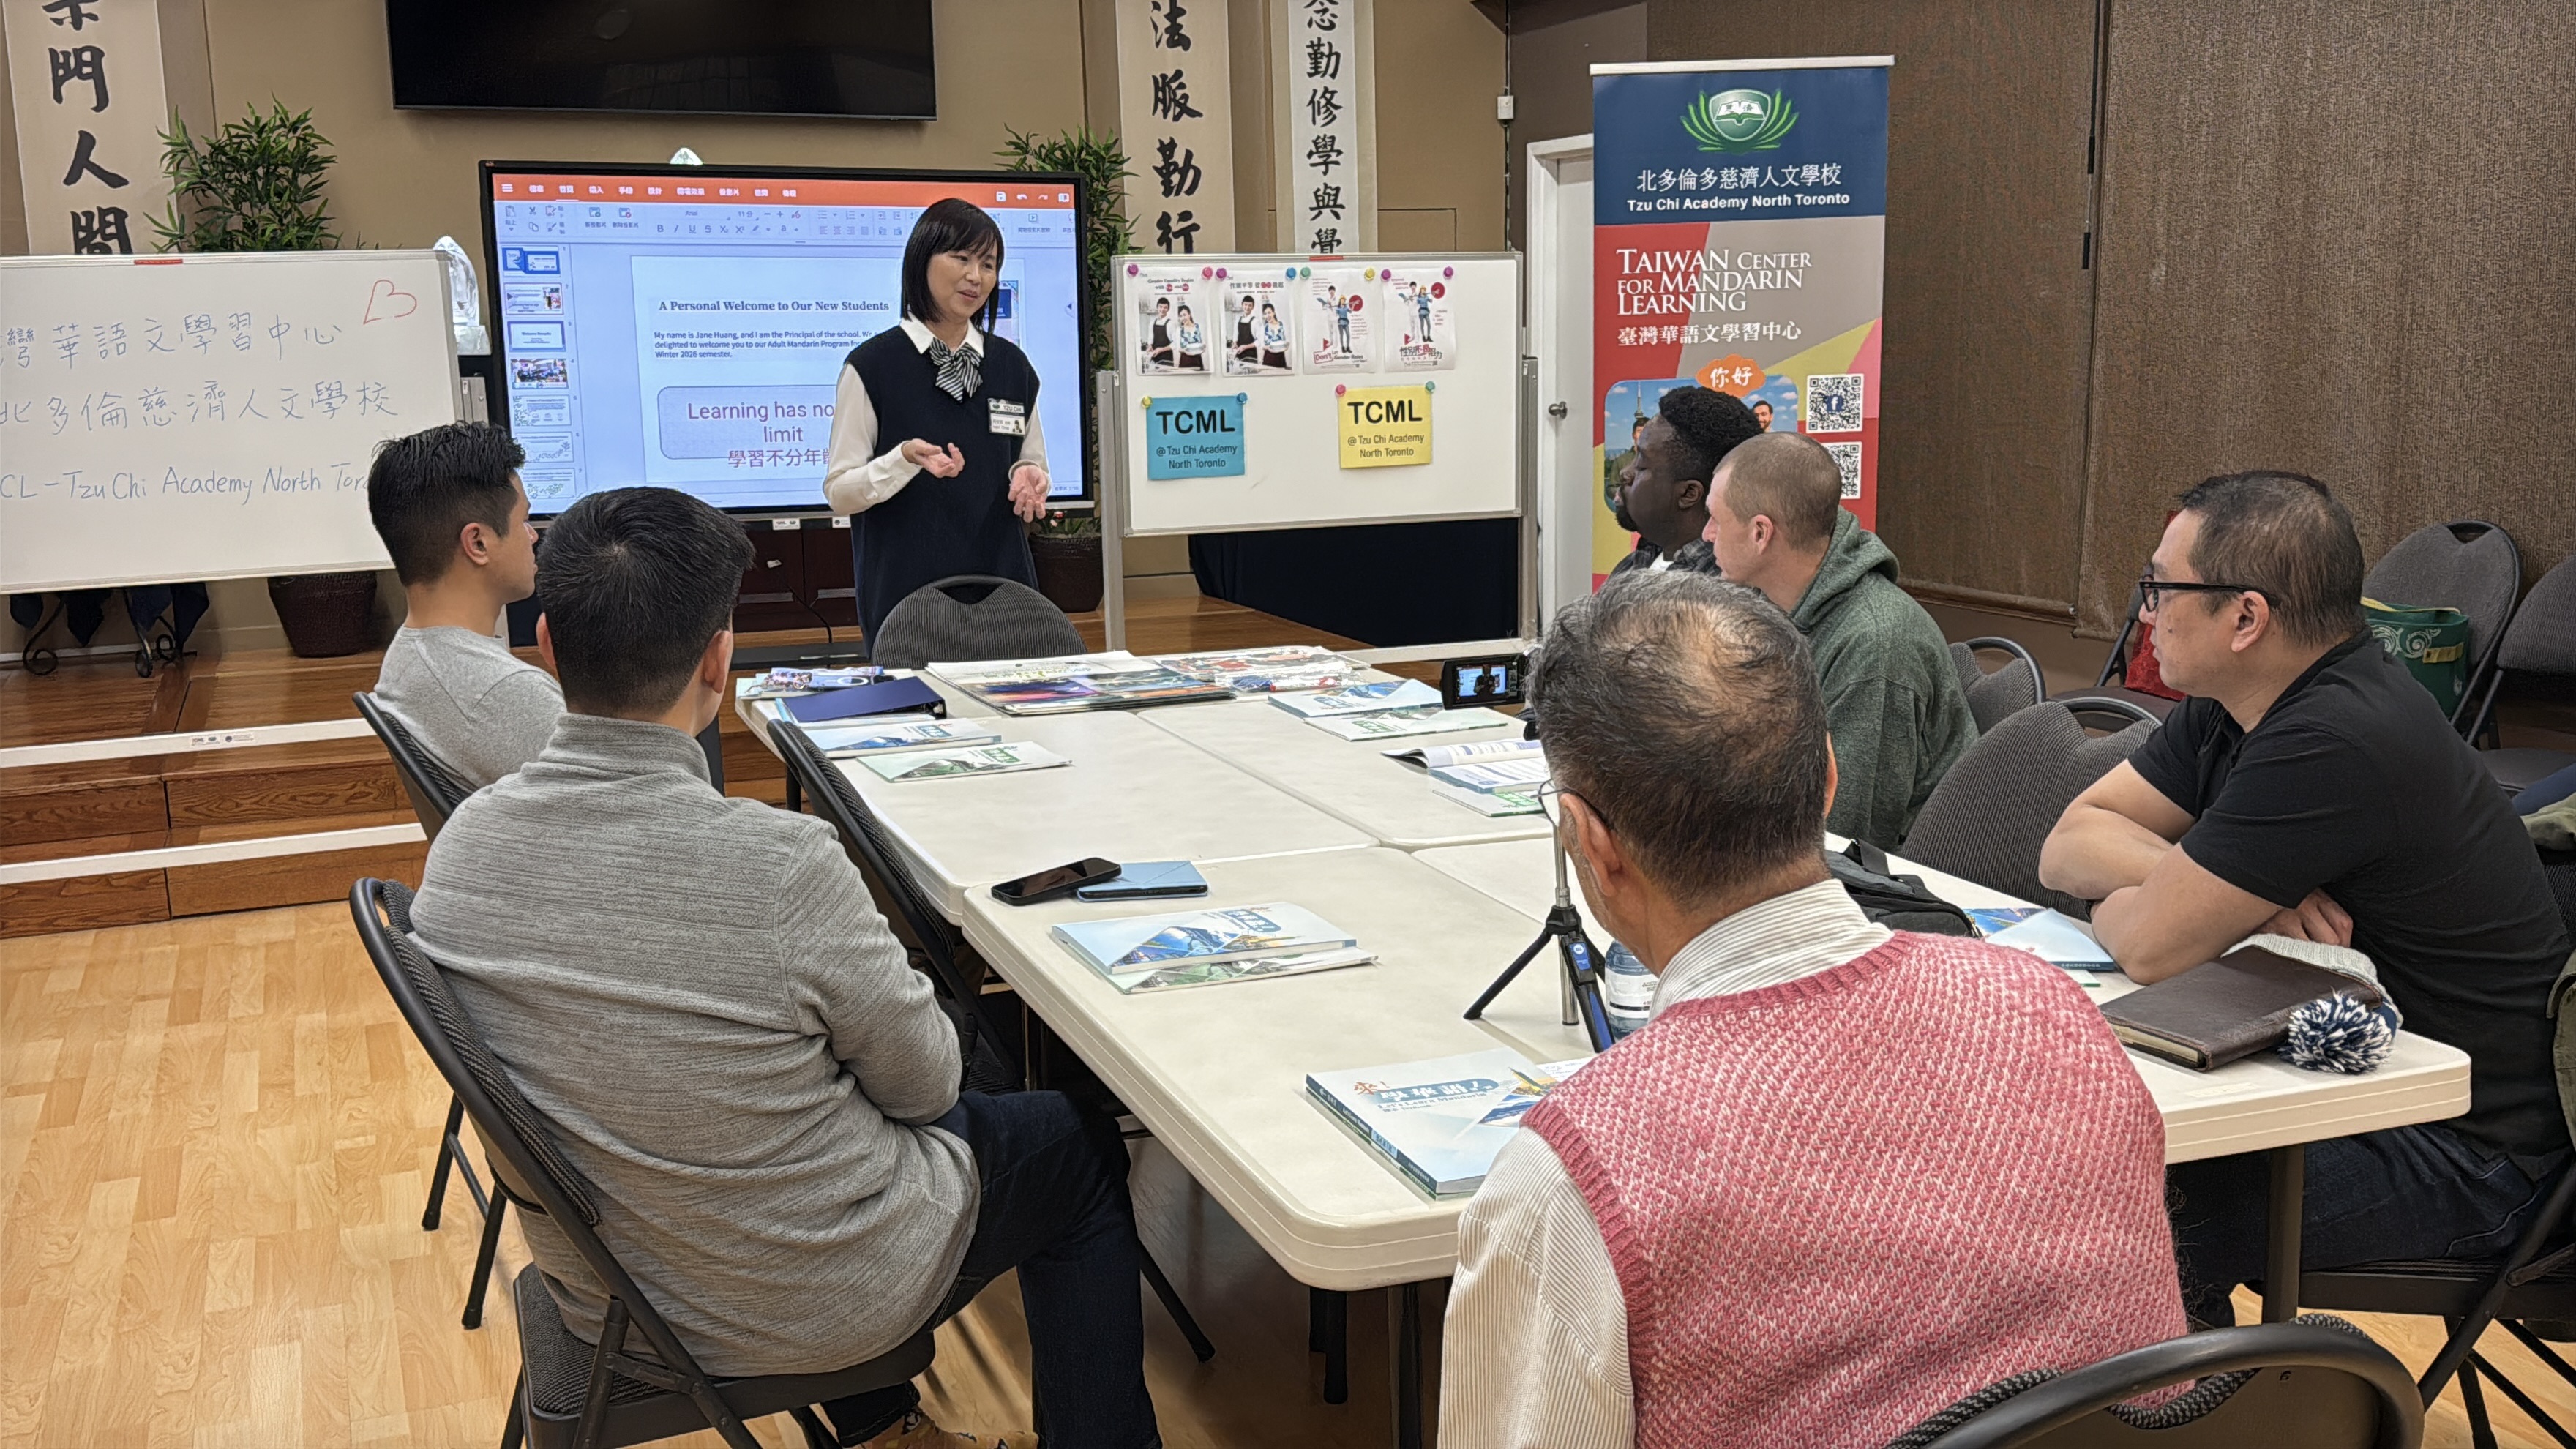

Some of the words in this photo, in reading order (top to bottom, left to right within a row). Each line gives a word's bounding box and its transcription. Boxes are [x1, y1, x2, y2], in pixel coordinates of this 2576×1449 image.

[1636, 163, 1842, 192] 北多倫多慈濟人文學校
[1627, 198, 1652, 211] Tzu
[1656, 197, 1680, 211] Chi
[1683, 195, 1748, 211] Academy
[1752, 194, 1792, 209] North
[1795, 192, 1850, 206] Toronto
[659, 301, 667, 311] A
[670, 300, 721, 311] Personal
[723, 300, 775, 311] Welcome
[777, 302, 789, 311] to
[791, 301, 813, 311] Our
[815, 301, 839, 311] New
[842, 300, 890, 311] Students
[654, 332, 665, 340] My
[688, 331, 694, 339] is
[714, 332, 739, 340] Huang,
[784, 331, 814, 339] Principal
[1617, 321, 1802, 346] 臺灣華語文學習中心
[654, 341, 689, 350] delighted
[731, 342, 744, 350] you
[768, 340, 786, 348] Adult
[787, 340, 820, 348] Mandarin
[820, 340, 850, 349] Program
[655, 351, 679, 359] Winter
[680, 351, 697, 359] 2026
[698, 351, 733, 359] semester.
[1710, 365, 1753, 389] 你好
[0, 380, 398, 435] 北多倫慈濟人文學校
[687, 402, 768, 422] Learning
[774, 401, 807, 418] has
[812, 404, 835, 417] no
[1347, 399, 1423, 424] TCML
[1155, 409, 1235, 435] TCML
[763, 426, 804, 443] limit
[1347, 436, 1357, 446] @
[1358, 435, 1371, 444] Tzu
[1374, 435, 1386, 443] Chi
[1388, 433, 1424, 443] Academy
[1156, 446, 1166, 457] @
[1167, 446, 1180, 455] Tzu
[1183, 445, 1197, 454] Chi
[1199, 444, 1238, 455] Academy
[1360, 449, 1382, 458] North
[1385, 447, 1414, 457] Toronto
[1169, 460, 1191, 469] North
[1194, 458, 1226, 468] Toronto
[112, 472, 146, 500] Chi
[162, 466, 254, 505] Academy
[263, 466, 321, 495] North
